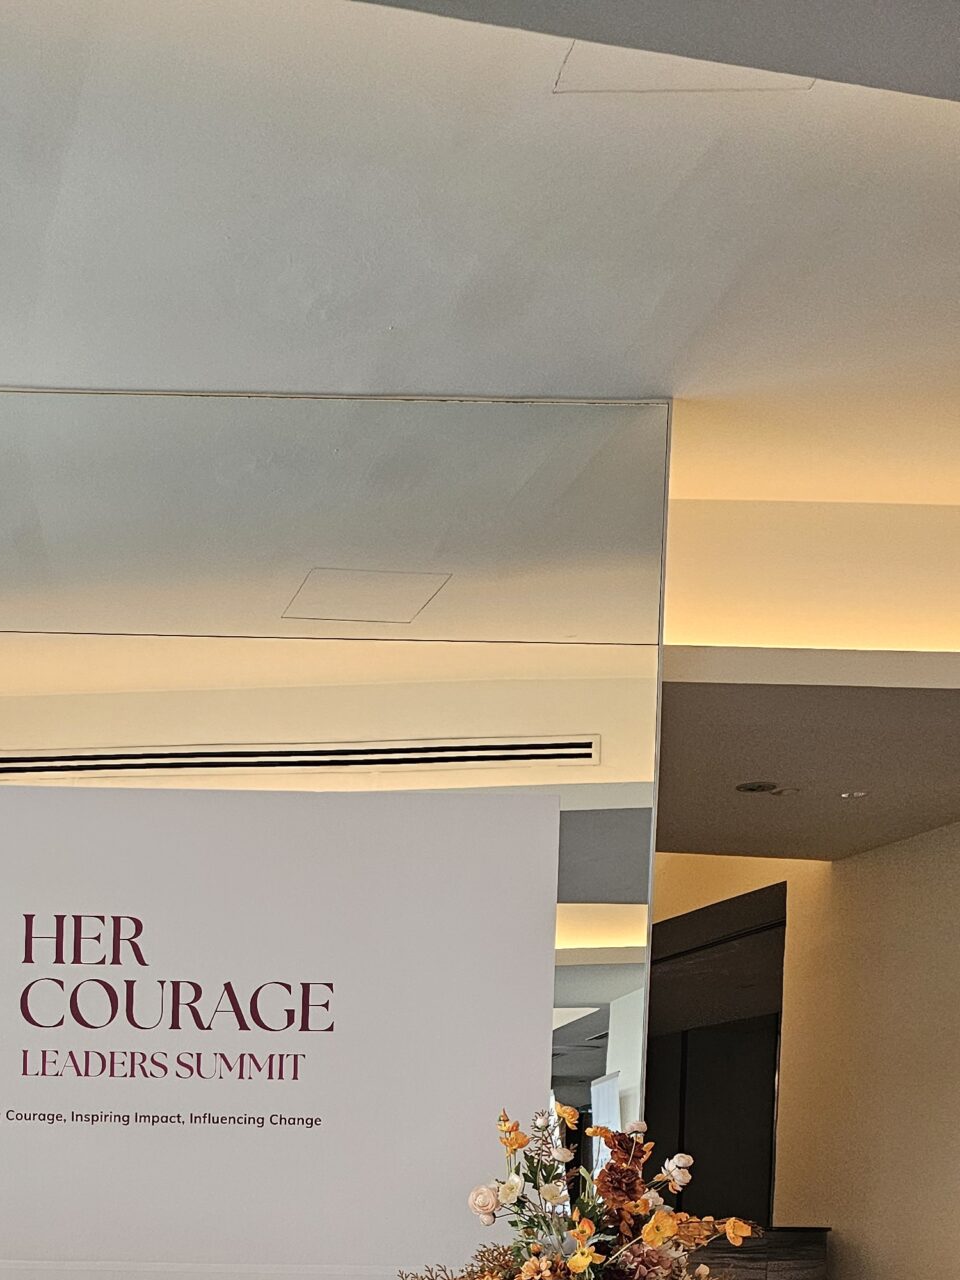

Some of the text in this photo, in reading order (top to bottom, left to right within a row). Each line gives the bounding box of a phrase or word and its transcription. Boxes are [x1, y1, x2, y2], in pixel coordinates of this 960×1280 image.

[21, 913, 149, 967] HER
[19, 977, 335, 1032] COURAGE
[21, 1049, 306, 1081] LEADERS SUMMIT
[5, 1109, 68, 1125] Courage,
[70, 1111, 131, 1126] Inspiring
[134, 1112, 186, 1127] Impact,
[189, 1113, 265, 1128] Influencing
[269, 1114, 322, 1129] Change
